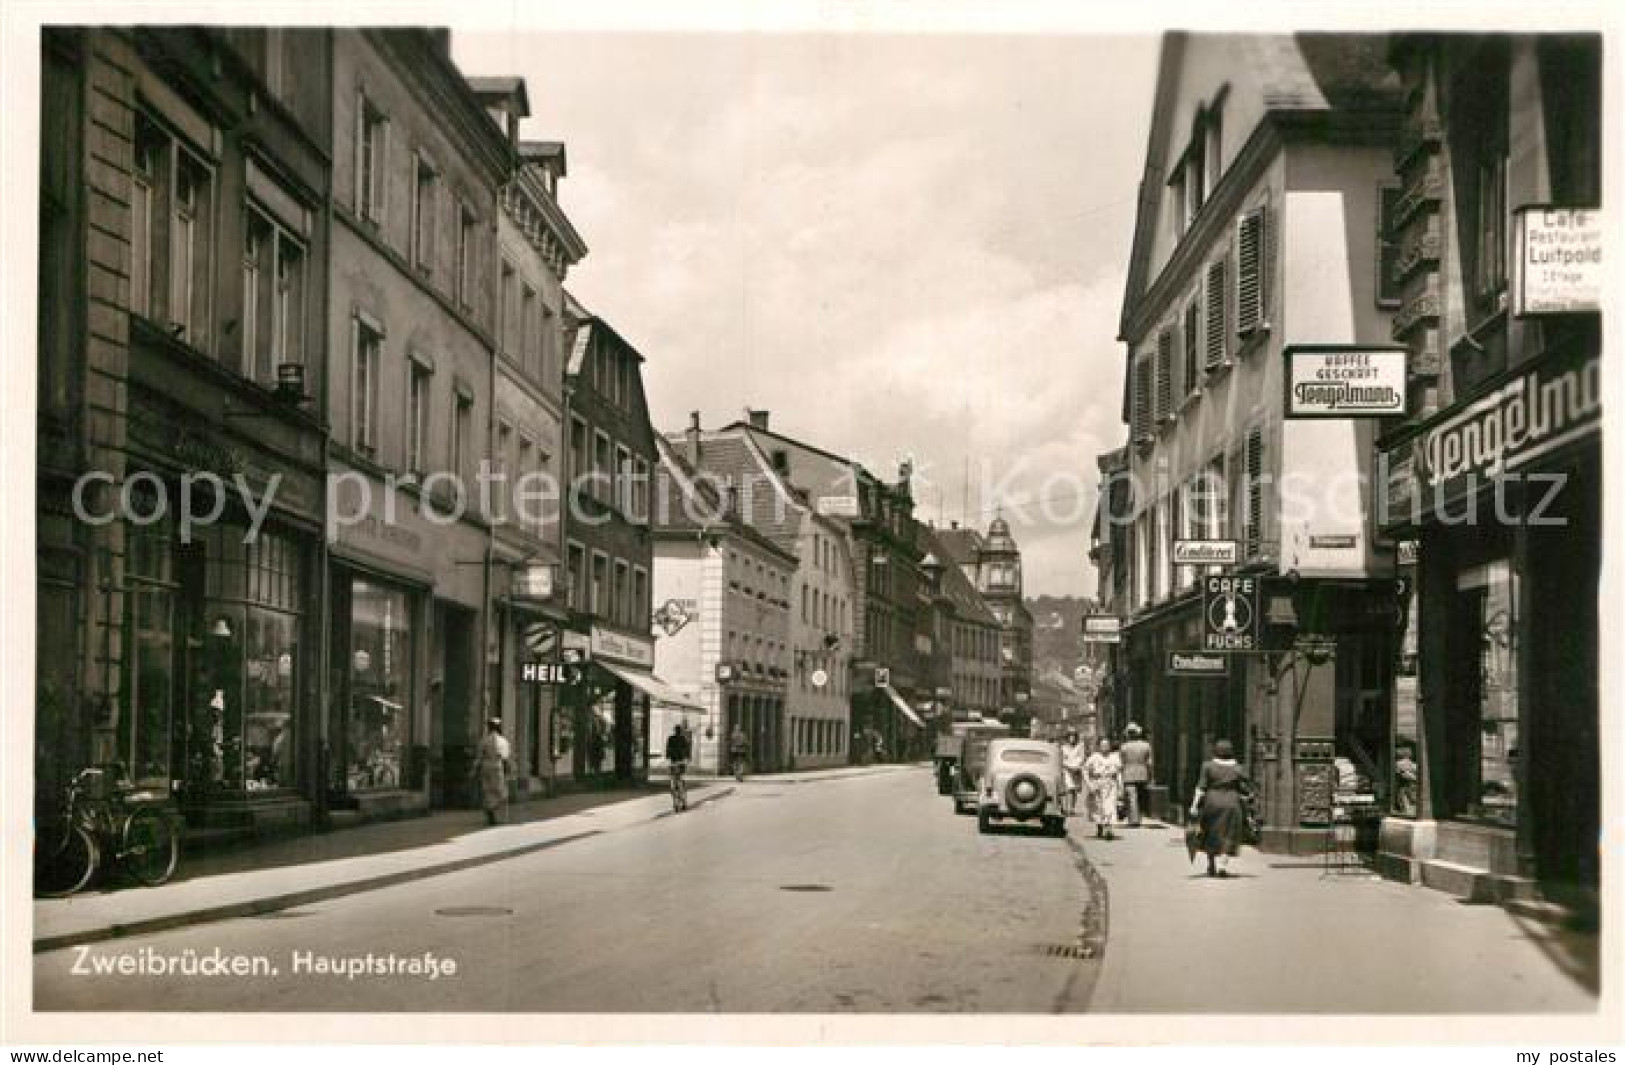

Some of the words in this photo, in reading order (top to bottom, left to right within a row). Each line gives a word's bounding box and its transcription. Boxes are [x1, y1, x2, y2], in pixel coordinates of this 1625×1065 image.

[1529, 246, 1600, 266] Luitpold
[1324, 354, 1369, 366] KAFFEE
[1295, 380, 1400, 409] Tengelmann
[1206, 632, 1253, 649] FUCHS
[522, 662, 567, 683] HEIL
